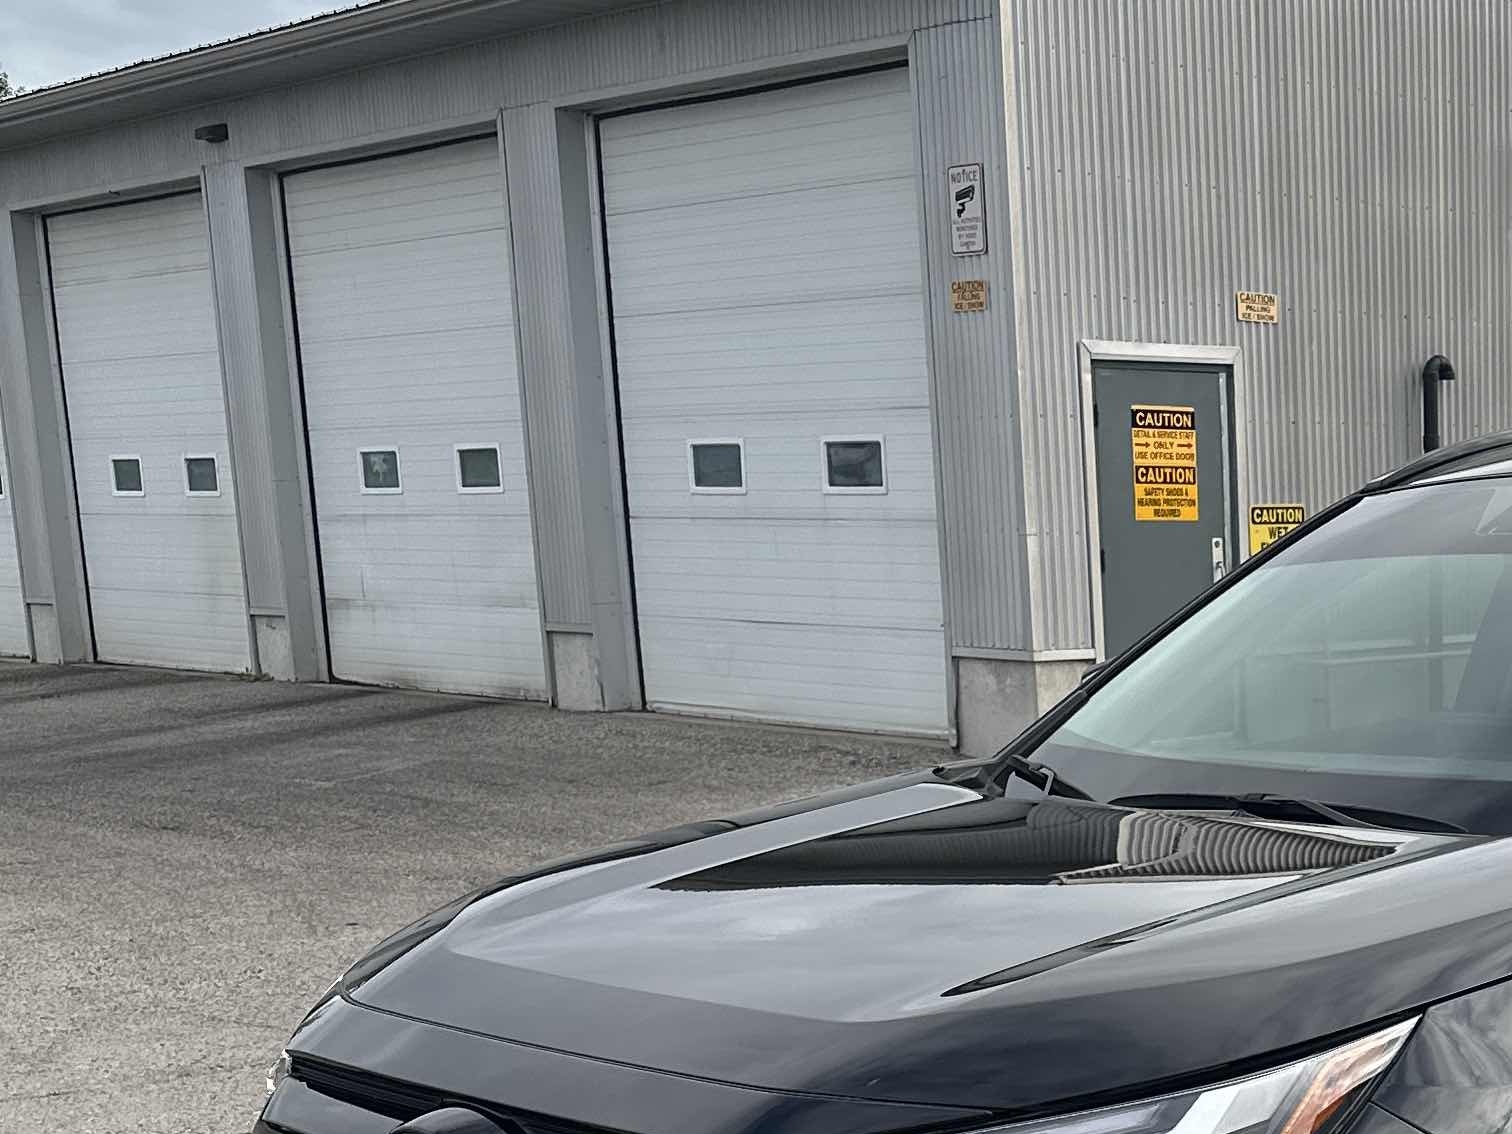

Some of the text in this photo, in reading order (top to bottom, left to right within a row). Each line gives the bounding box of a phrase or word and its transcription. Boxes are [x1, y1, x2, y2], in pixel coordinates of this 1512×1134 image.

[951, 169, 978, 184] NOTICE
[952, 280, 984, 293] CAUTION
[1240, 292, 1275, 305] CAUTION
[1136, 411, 1192, 428] CAUTION
[1153, 441, 1174, 450] ONLY
[1135, 451, 1195, 461] USE OFFICE DOOR
[1137, 467, 1194, 483] CAUTION
[1253, 508, 1303, 523] CAUTION
